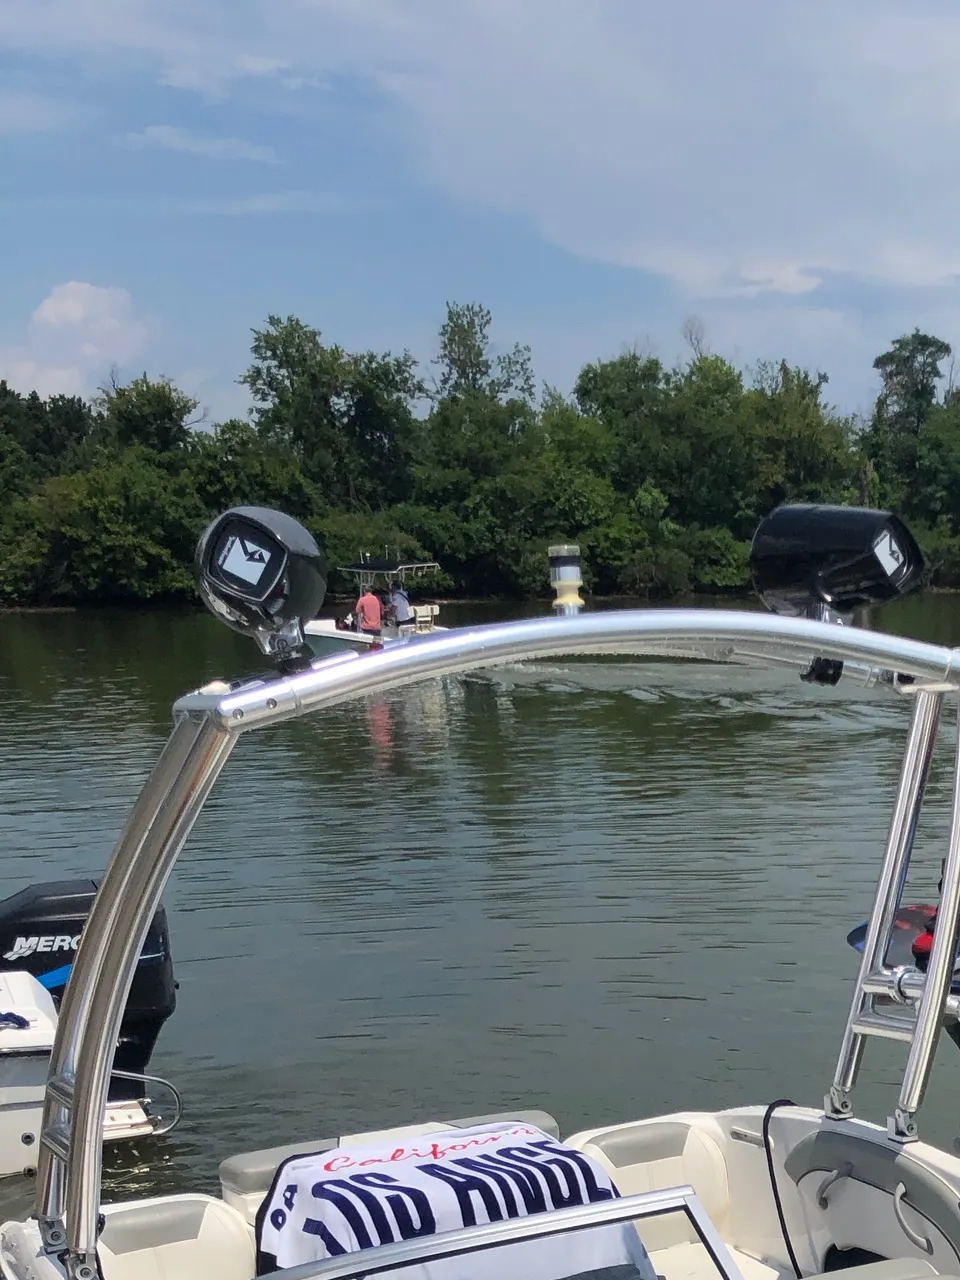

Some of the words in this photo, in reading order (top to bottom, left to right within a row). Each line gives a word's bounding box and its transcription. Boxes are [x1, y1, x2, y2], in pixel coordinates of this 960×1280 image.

[5, 935, 83, 960] MERC
[323, 1127, 535, 1172] Californ
[414, 1139, 620, 1228] ANGE
